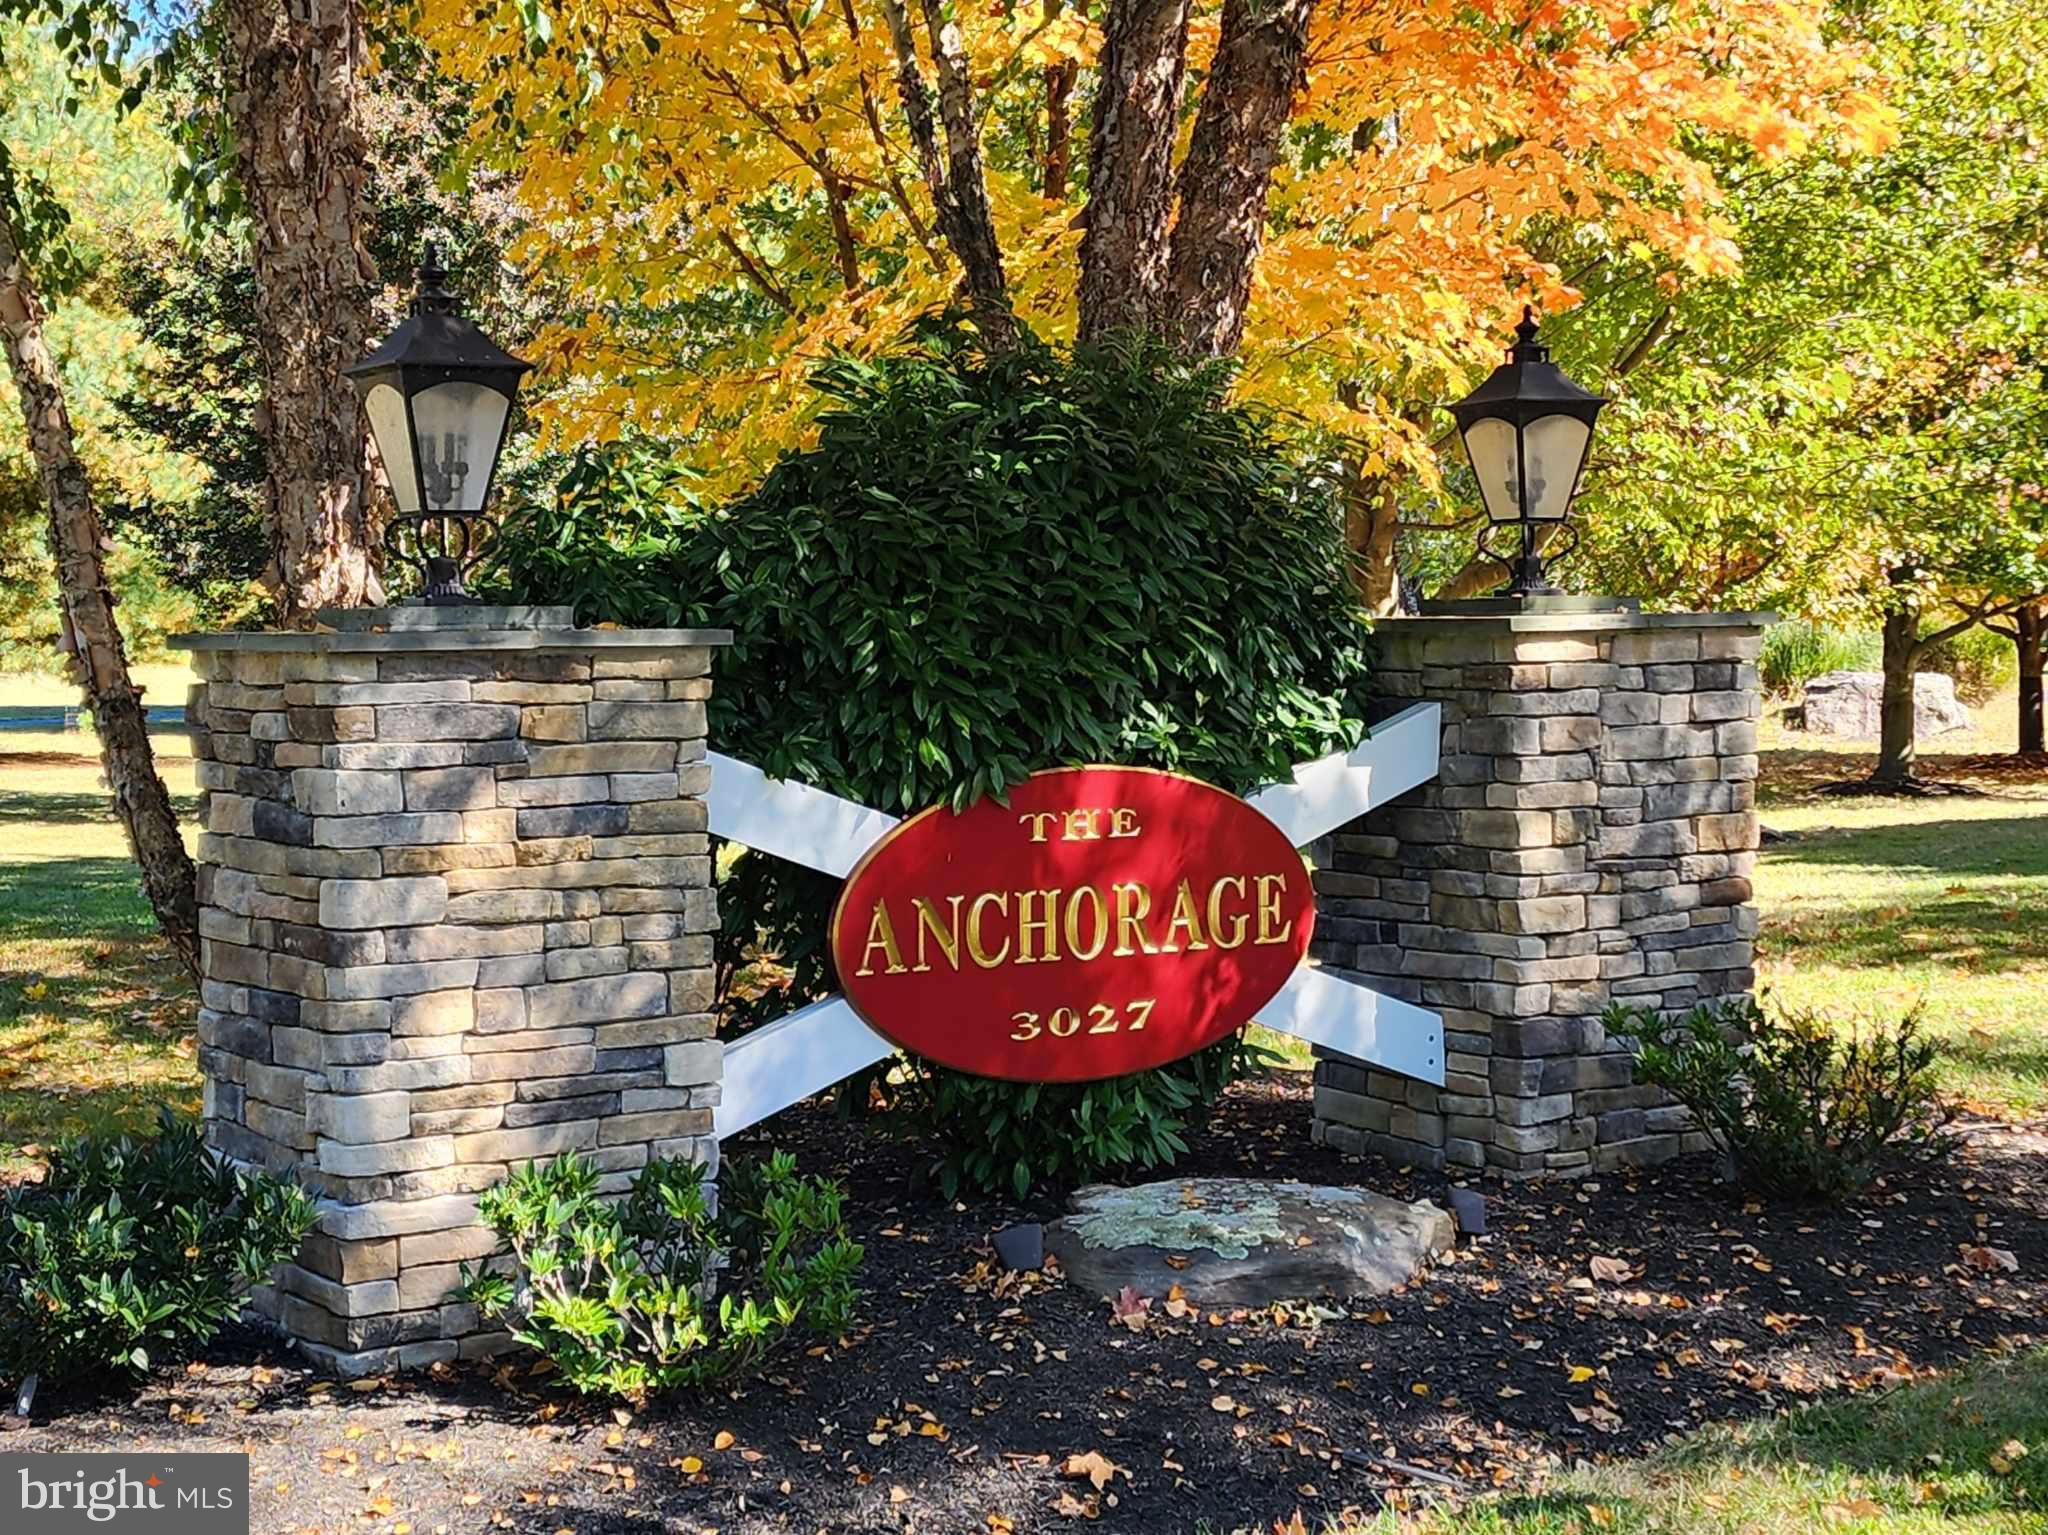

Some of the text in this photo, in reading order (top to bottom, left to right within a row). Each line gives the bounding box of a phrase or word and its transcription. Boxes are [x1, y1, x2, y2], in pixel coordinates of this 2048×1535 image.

[1018, 808, 1142, 843] THE
[855, 873, 1293, 977] ANCHORAGE
[1010, 998, 1157, 1041] 3027
